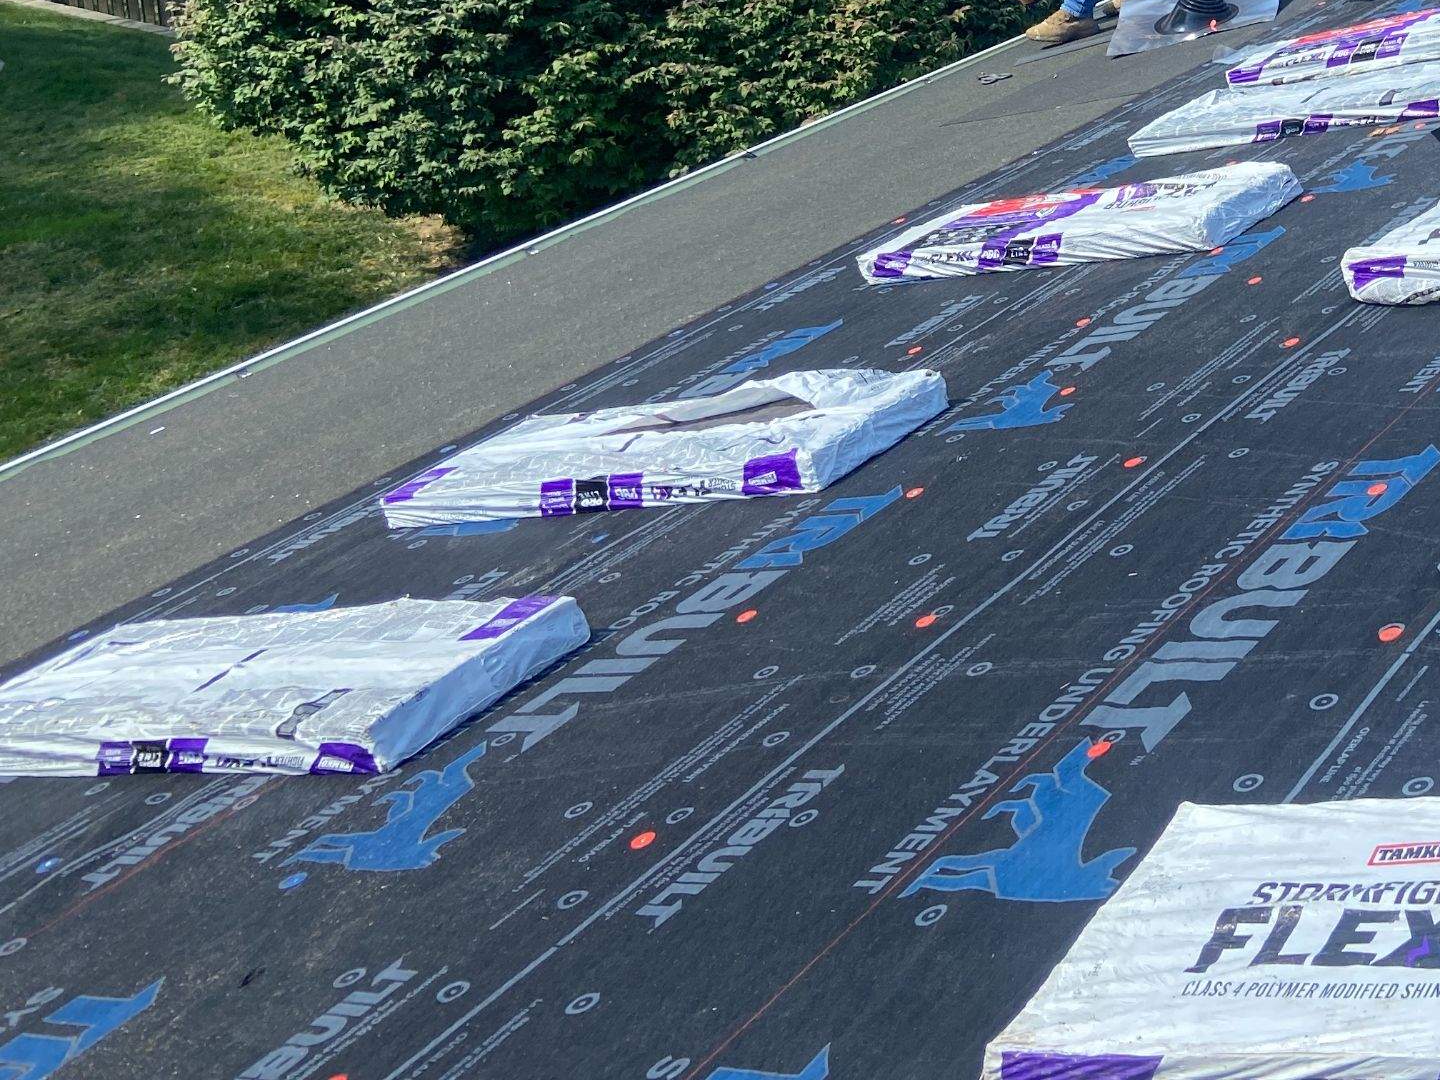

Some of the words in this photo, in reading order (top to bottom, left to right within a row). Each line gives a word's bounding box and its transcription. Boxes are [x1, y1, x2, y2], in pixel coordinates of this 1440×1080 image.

[1245, 348, 1352, 424] TRIBUILT
[578, 490, 601, 500] LINE
[580, 496, 603, 507] PRO
[675, 497, 823, 589] SYNTHETIC
[967, 452, 1099, 542] TRIBUILT
[1215, 460, 1340, 560] SYNTHETIC
[486, 484, 903, 754] TRIBUILT
[1103, 562, 1230, 662] ROOFING
[853, 665, 1117, 895] UNDERLAYMENT
[81, 774, 274, 896] RIBUILT
[634, 763, 846, 929] TRIBUILT
[242, 956, 419, 1080] BUILT
[1182, 980, 1232, 998] CLASS
[1233, 981, 1244, 998] 4
[1246, 981, 1319, 999] POLYMER
[1320, 981, 1400, 1000] MODIFIED
